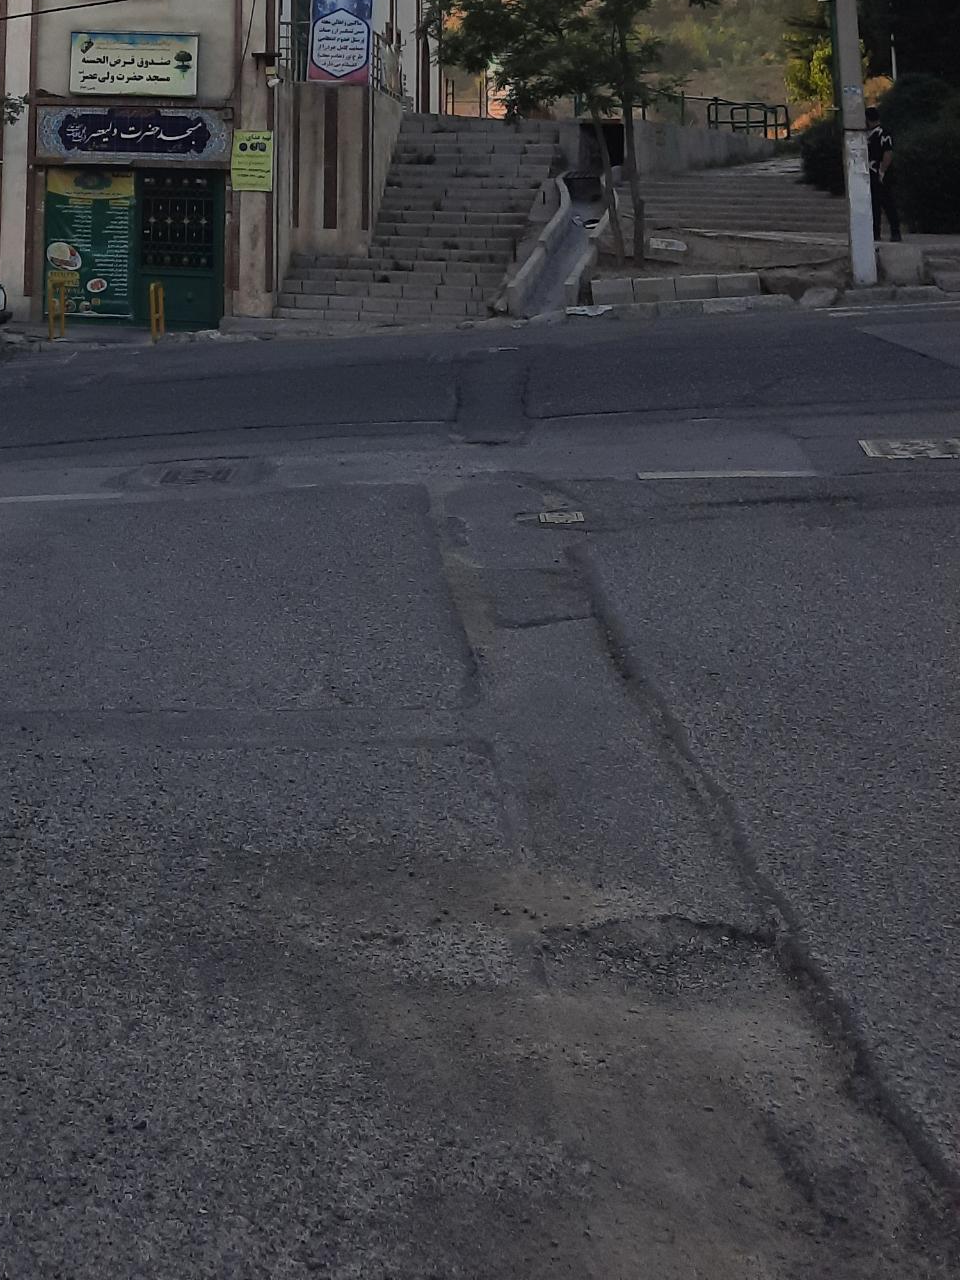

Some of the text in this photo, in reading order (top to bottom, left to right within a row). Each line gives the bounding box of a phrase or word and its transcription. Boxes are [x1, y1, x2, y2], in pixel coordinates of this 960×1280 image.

[109, 55, 136, 67] قرض
[137, 56, 171, 68] صندوق
[116, 71, 144, 83] حضرت
[146, 74, 171, 84] مسجد
[119, 124, 161, 143] حضرت
[157, 122, 202, 145] مسجد
